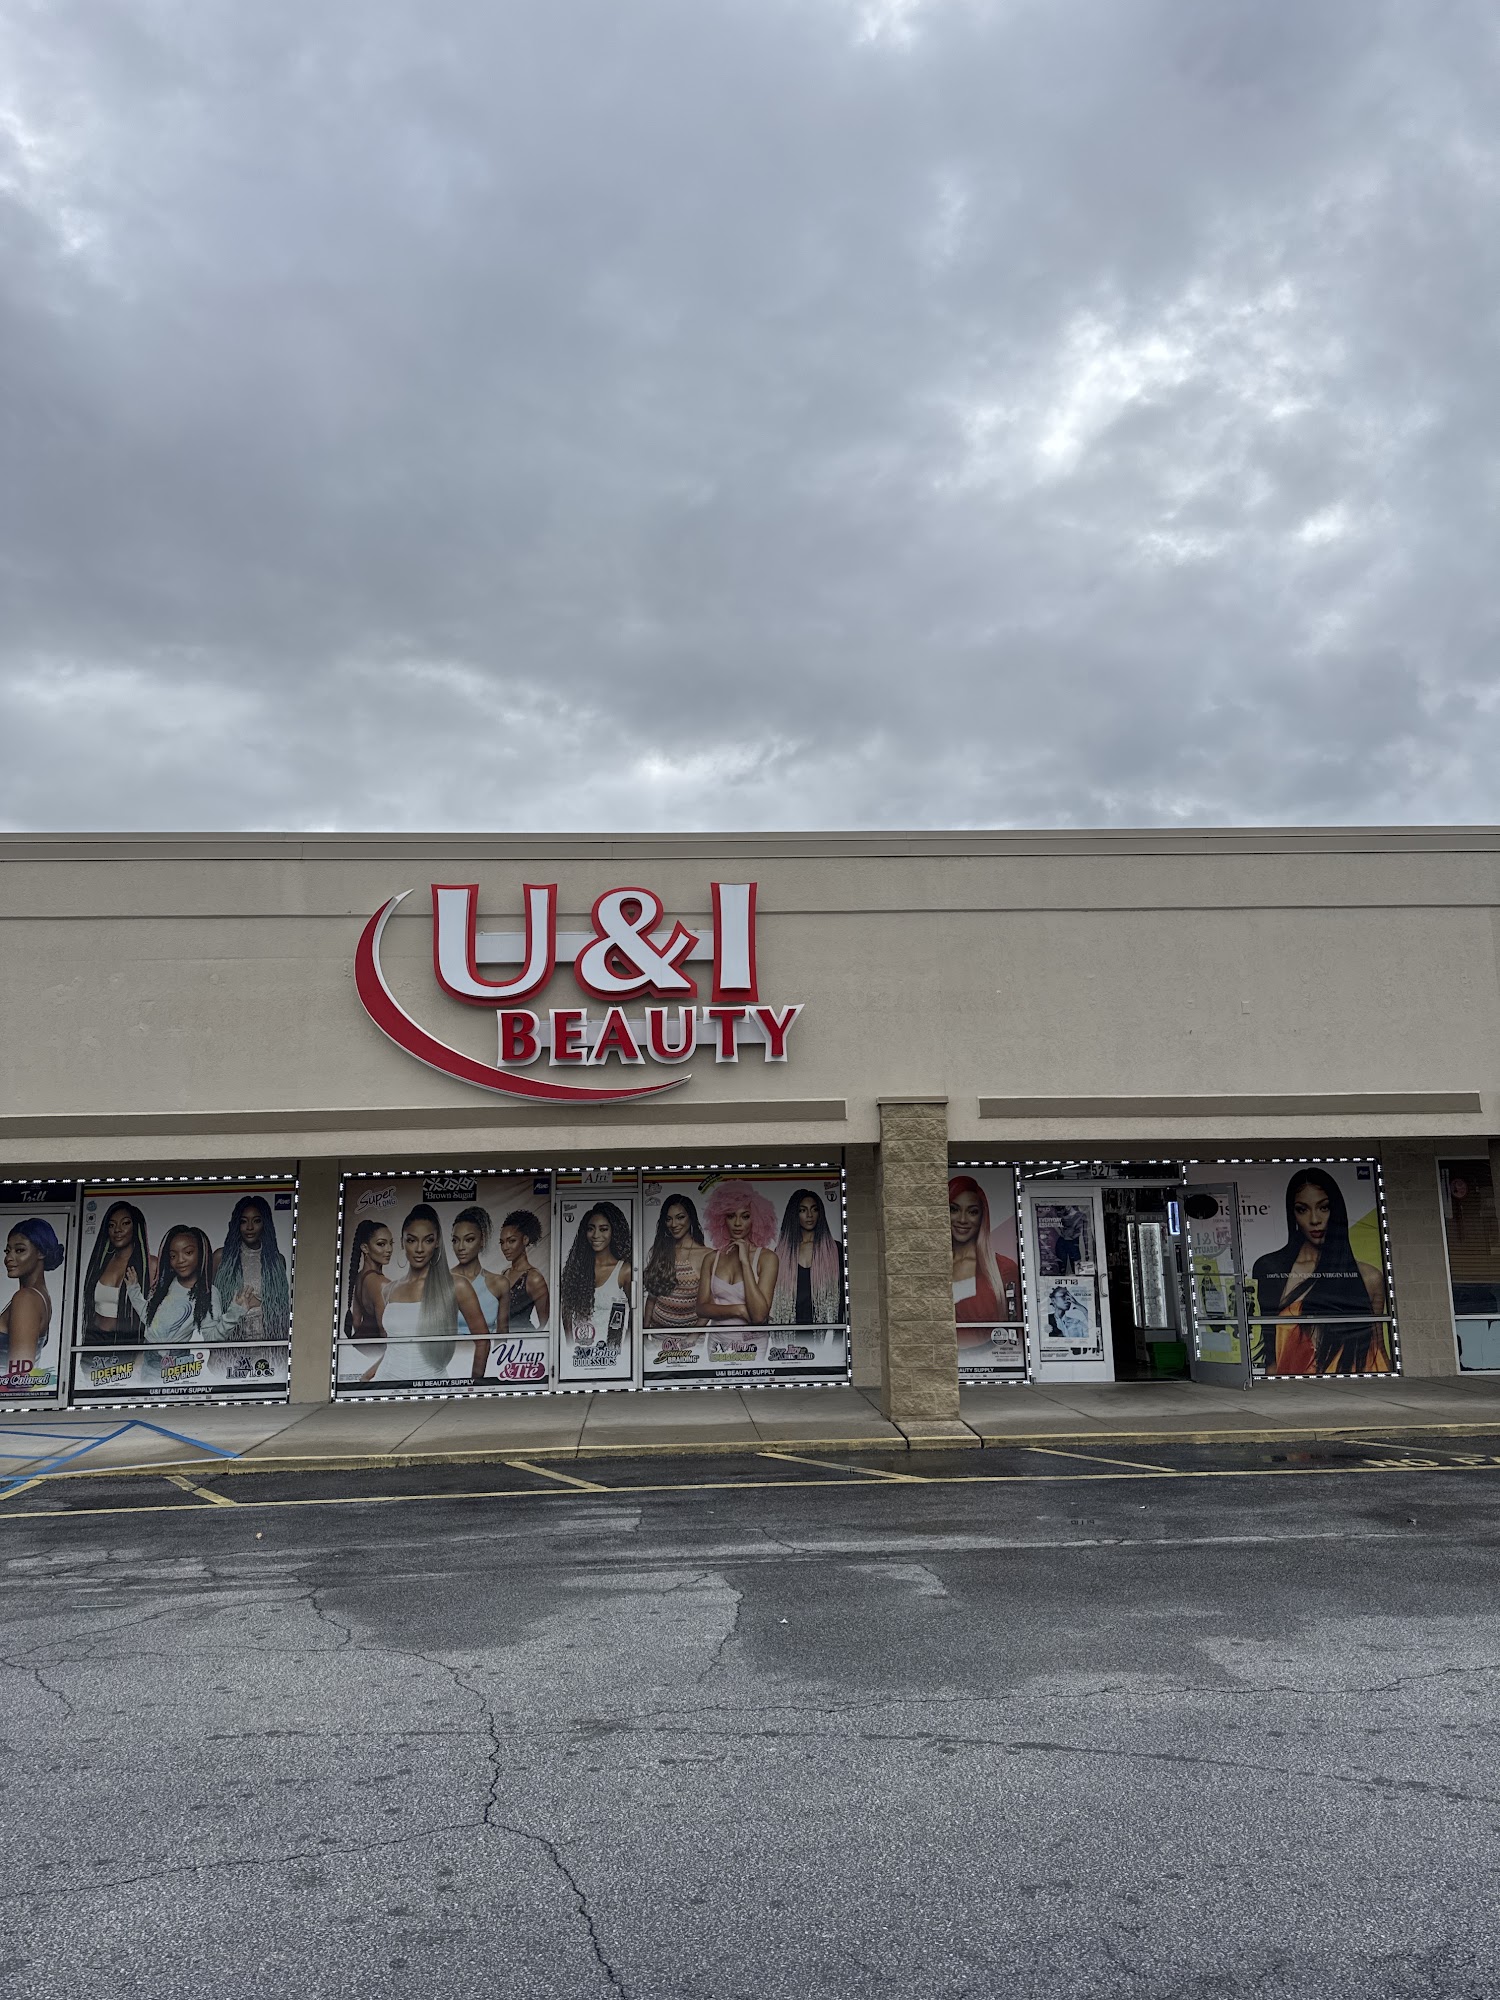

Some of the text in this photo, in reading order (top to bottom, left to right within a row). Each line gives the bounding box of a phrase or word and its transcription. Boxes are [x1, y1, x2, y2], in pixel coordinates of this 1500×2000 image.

[431, 882, 758, 1007] U&I
[497, 1004, 805, 1066] BEAUTY
[1091, 1165, 1111, 1176] 527
[358, 1188, 395, 1211] Super
[378, 1198, 396, 1207] LONG
[425, 1190, 475, 1201] Brown Sugar
[491, 1339, 545, 1366] Wrap
[590, 1347, 618, 1358] Boho
[667, 1355, 698, 1364] BRAIDING
[8, 1359, 34, 1374] HD
[97, 1362, 134, 1380] DEFINE
[167, 1360, 203, 1378] DEFINE
[10, 1373, 50, 1386] Colored
[94, 1376, 111, 1387] EASY
[163, 1369, 201, 1384] EASY BRAID
